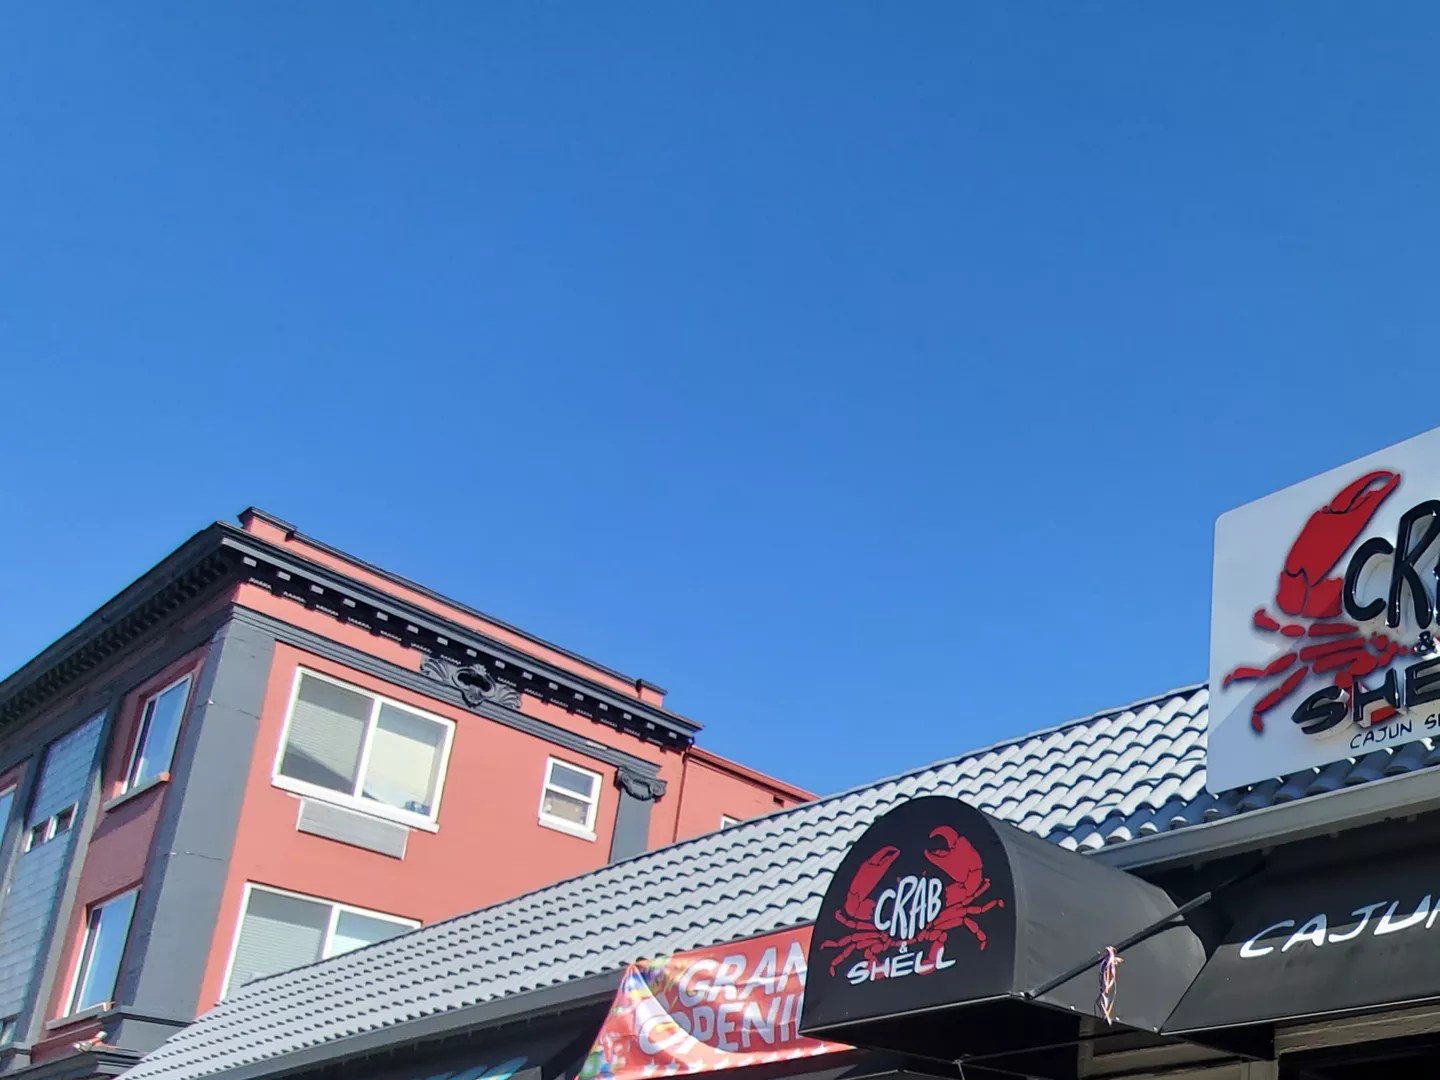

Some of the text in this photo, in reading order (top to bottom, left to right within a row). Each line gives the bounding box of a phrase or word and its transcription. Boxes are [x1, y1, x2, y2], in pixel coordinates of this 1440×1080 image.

[1415, 630, 1436, 655] &
[1349, 722, 1413, 750] CAJUN
[873, 874, 944, 939] CRAB
[898, 940, 909, 954] &
[846, 946, 957, 985] SHELL
